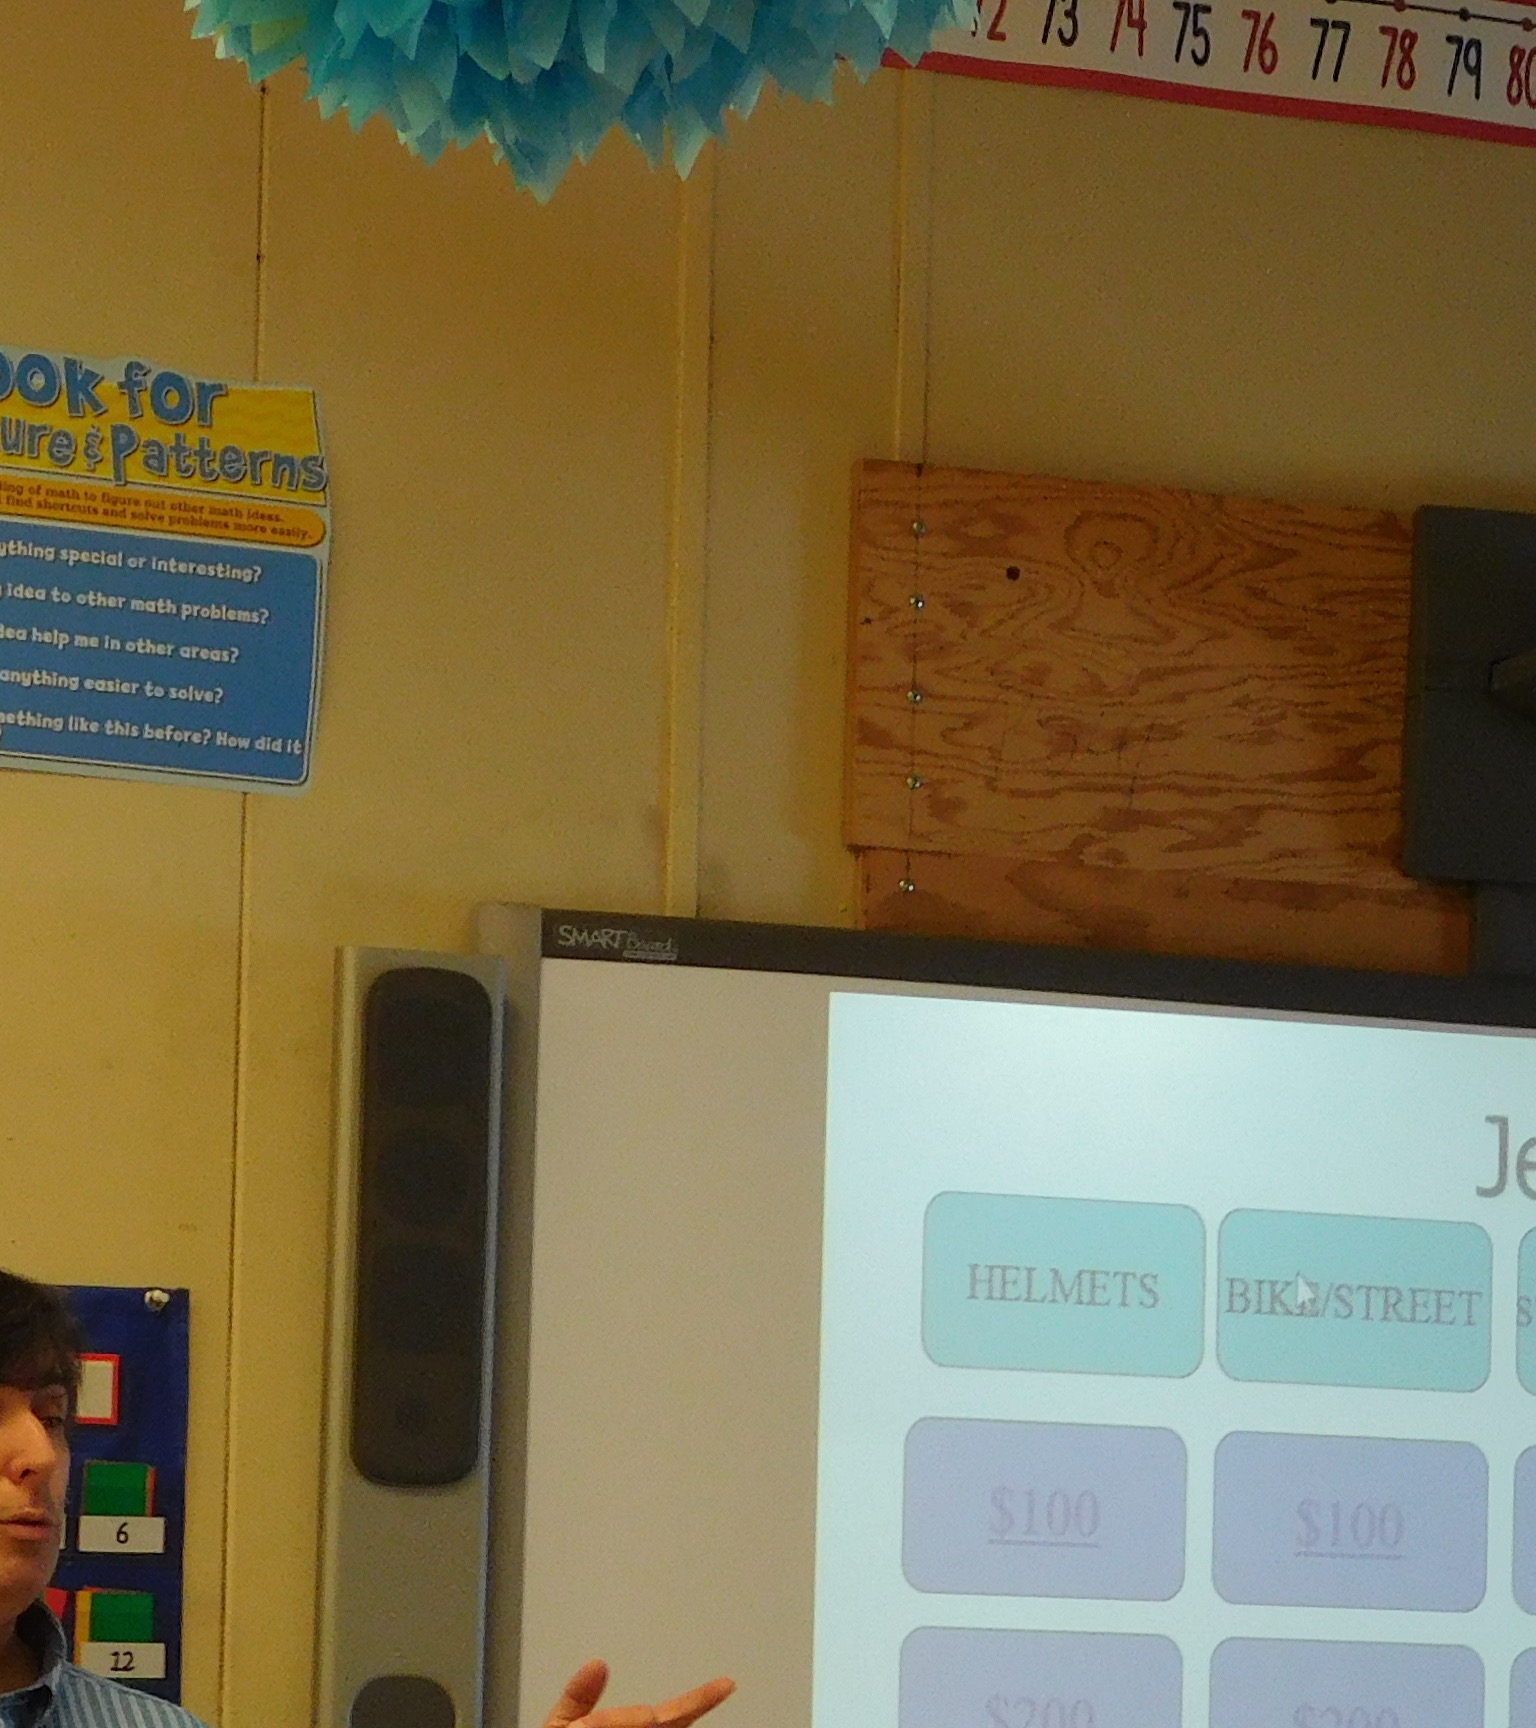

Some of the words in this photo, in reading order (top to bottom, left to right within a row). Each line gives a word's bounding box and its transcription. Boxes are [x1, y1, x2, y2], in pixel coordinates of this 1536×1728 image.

[1042, 0, 1078, 47] 73
[1110, 0, 1147, 57] 74
[1173, 4, 1212, 66] 75
[1242, 10, 1278, 75] 76
[1310, 18, 1350, 82] 77
[1379, 26, 1418, 90] 78
[1446, 35, 1482, 100] 79
[118, 362, 226, 425] for
[84, 425, 104, 469] &
[111, 422, 326, 490] Patterns
[58, 548, 122, 567] special
[126, 556, 147, 568] or
[151, 556, 262, 582] interesting?
[31, 626, 70, 650] help
[73, 634, 99, 647] me
[103, 634, 121, 650] in
[124, 637, 174, 655] other
[179, 645, 239, 663] areas?
[83, 678, 139, 694] easier
[143, 680, 164, 697] to
[168, 684, 223, 704] solve?
[558, 925, 627, 950] SMART
[967, 1262, 1161, 1308] HELMETS
[1225, 1276, 1483, 1327] BIKE/STREET
[116, 1522, 129, 1544] 6
[987, 1486, 1102, 1549] $100
[1294, 1500, 1405, 1560] $100
[110, 1651, 135, 1671] 12
